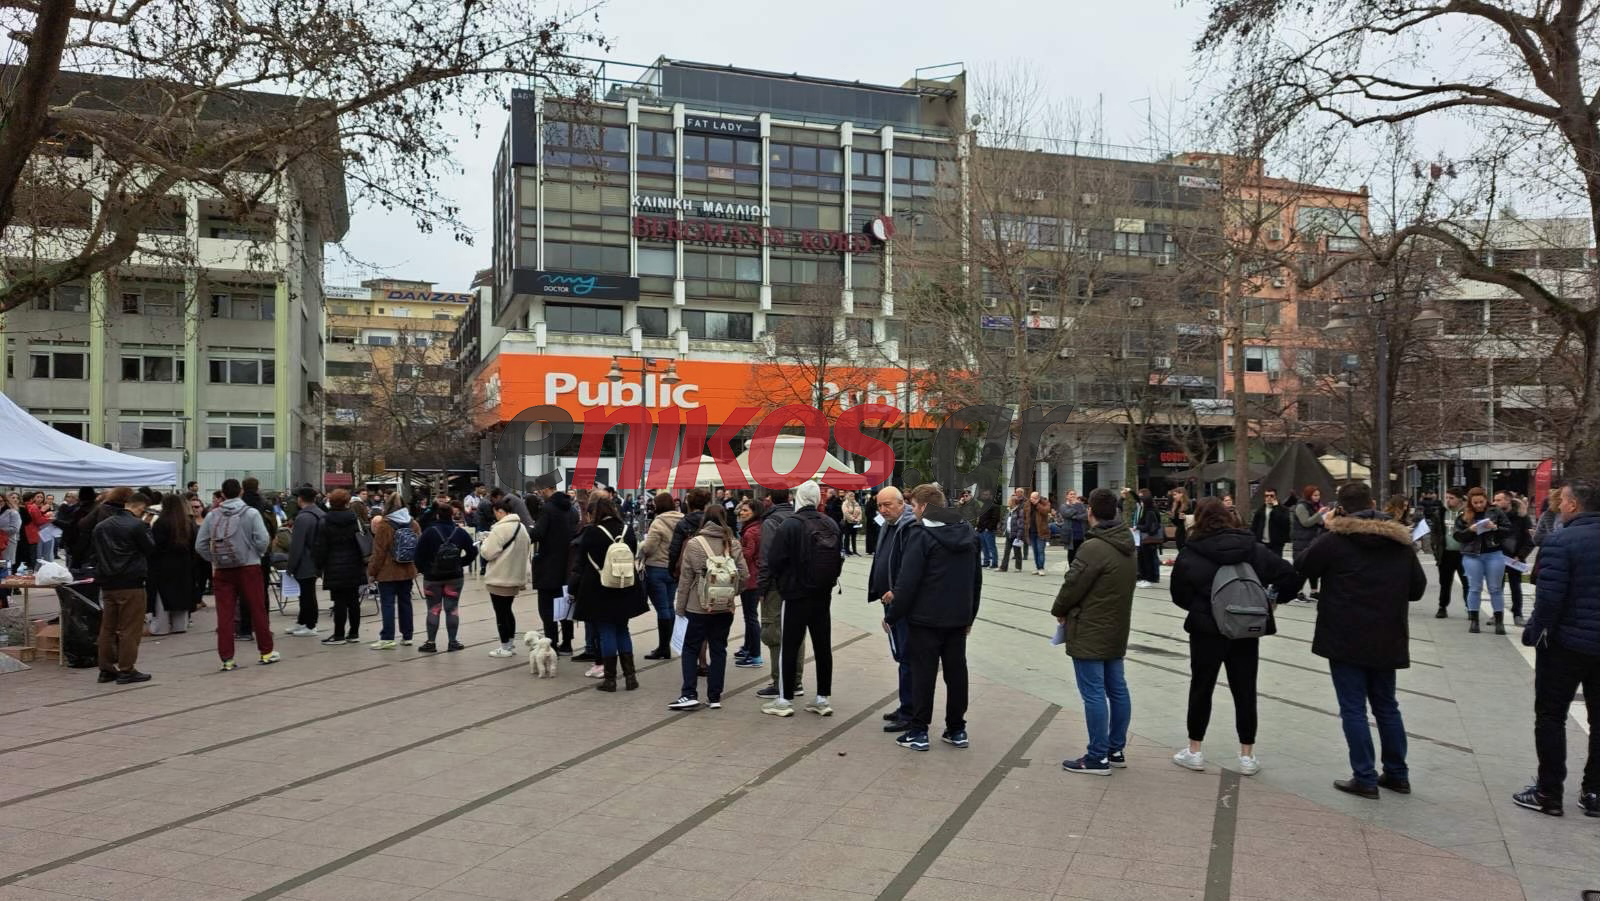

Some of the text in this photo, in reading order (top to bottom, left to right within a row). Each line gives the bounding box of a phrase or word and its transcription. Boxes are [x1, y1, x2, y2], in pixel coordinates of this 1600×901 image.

[687, 118, 742, 132] FAT LADY
[632, 216, 784, 246] BERGMANN
[537, 274, 600, 294] my
[543, 285, 569, 293] DOCTOR
[387, 290, 471, 304] DANZAS
[544, 372, 700, 409] Public
